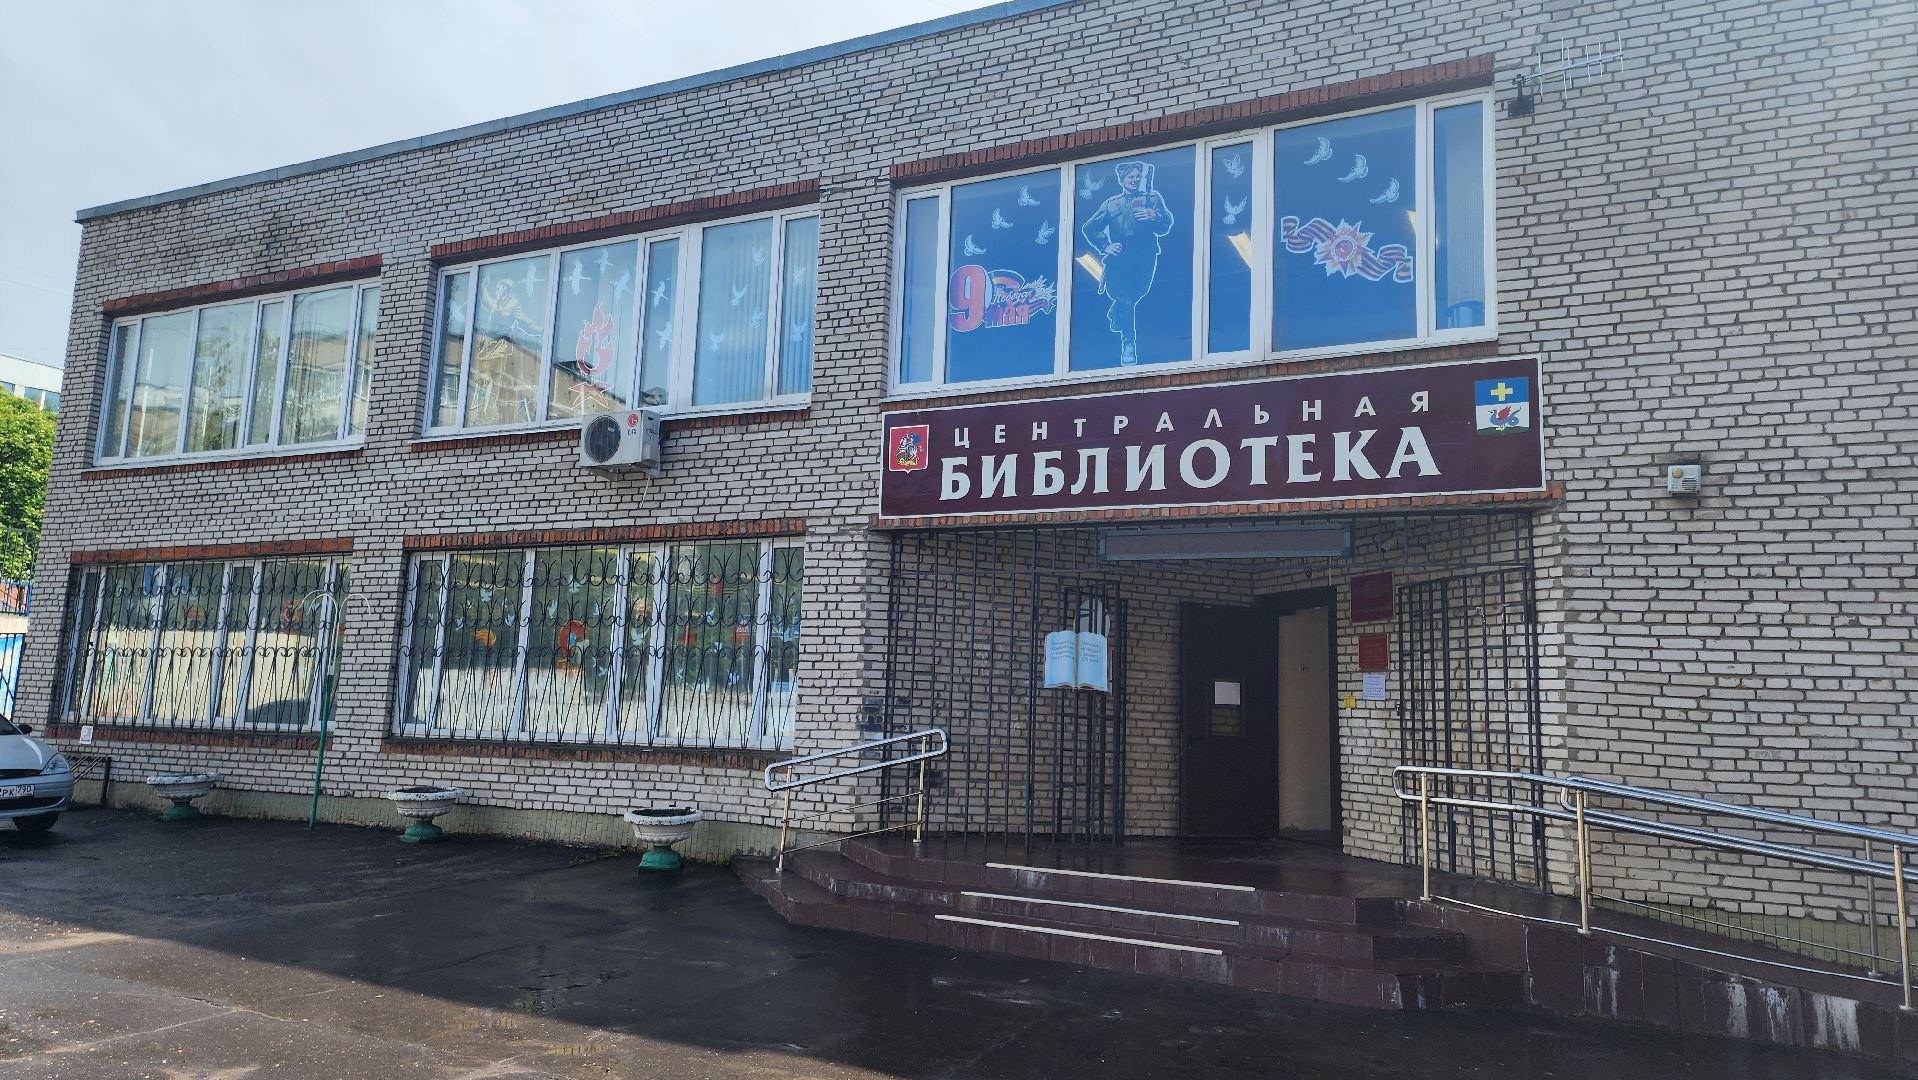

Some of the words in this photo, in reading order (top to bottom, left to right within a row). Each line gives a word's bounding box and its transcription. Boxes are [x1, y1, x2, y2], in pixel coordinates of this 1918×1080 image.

[950, 264, 986, 332] 9
[954, 390, 1429, 449] ЦЕНТРАЛЬНАЯ
[938, 426, 1443, 501] БИБЛИОТЕКА
